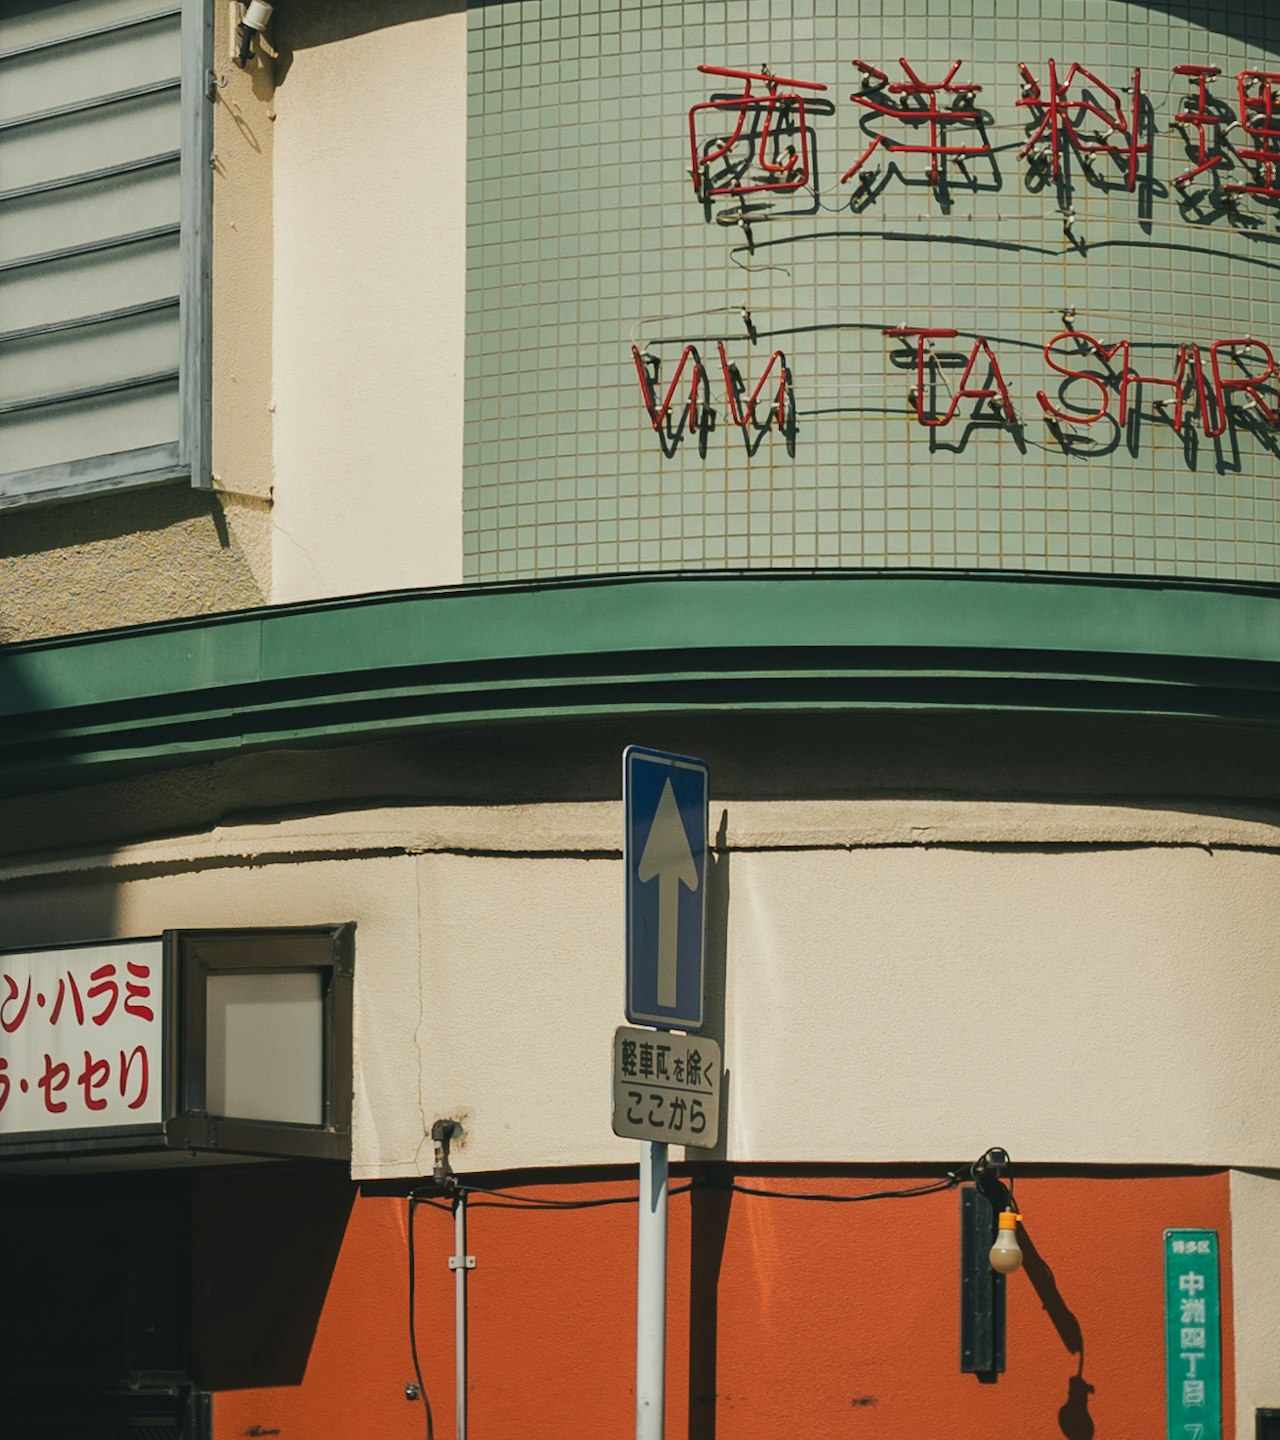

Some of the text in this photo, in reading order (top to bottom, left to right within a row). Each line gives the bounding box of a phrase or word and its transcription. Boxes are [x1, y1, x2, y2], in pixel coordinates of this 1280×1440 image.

[621, 1038, 713, 1087] 軽車両を除く
[626, 1091, 707, 1134] ここから
[1178, 1270, 1206, 1408] 中洲四丁目
